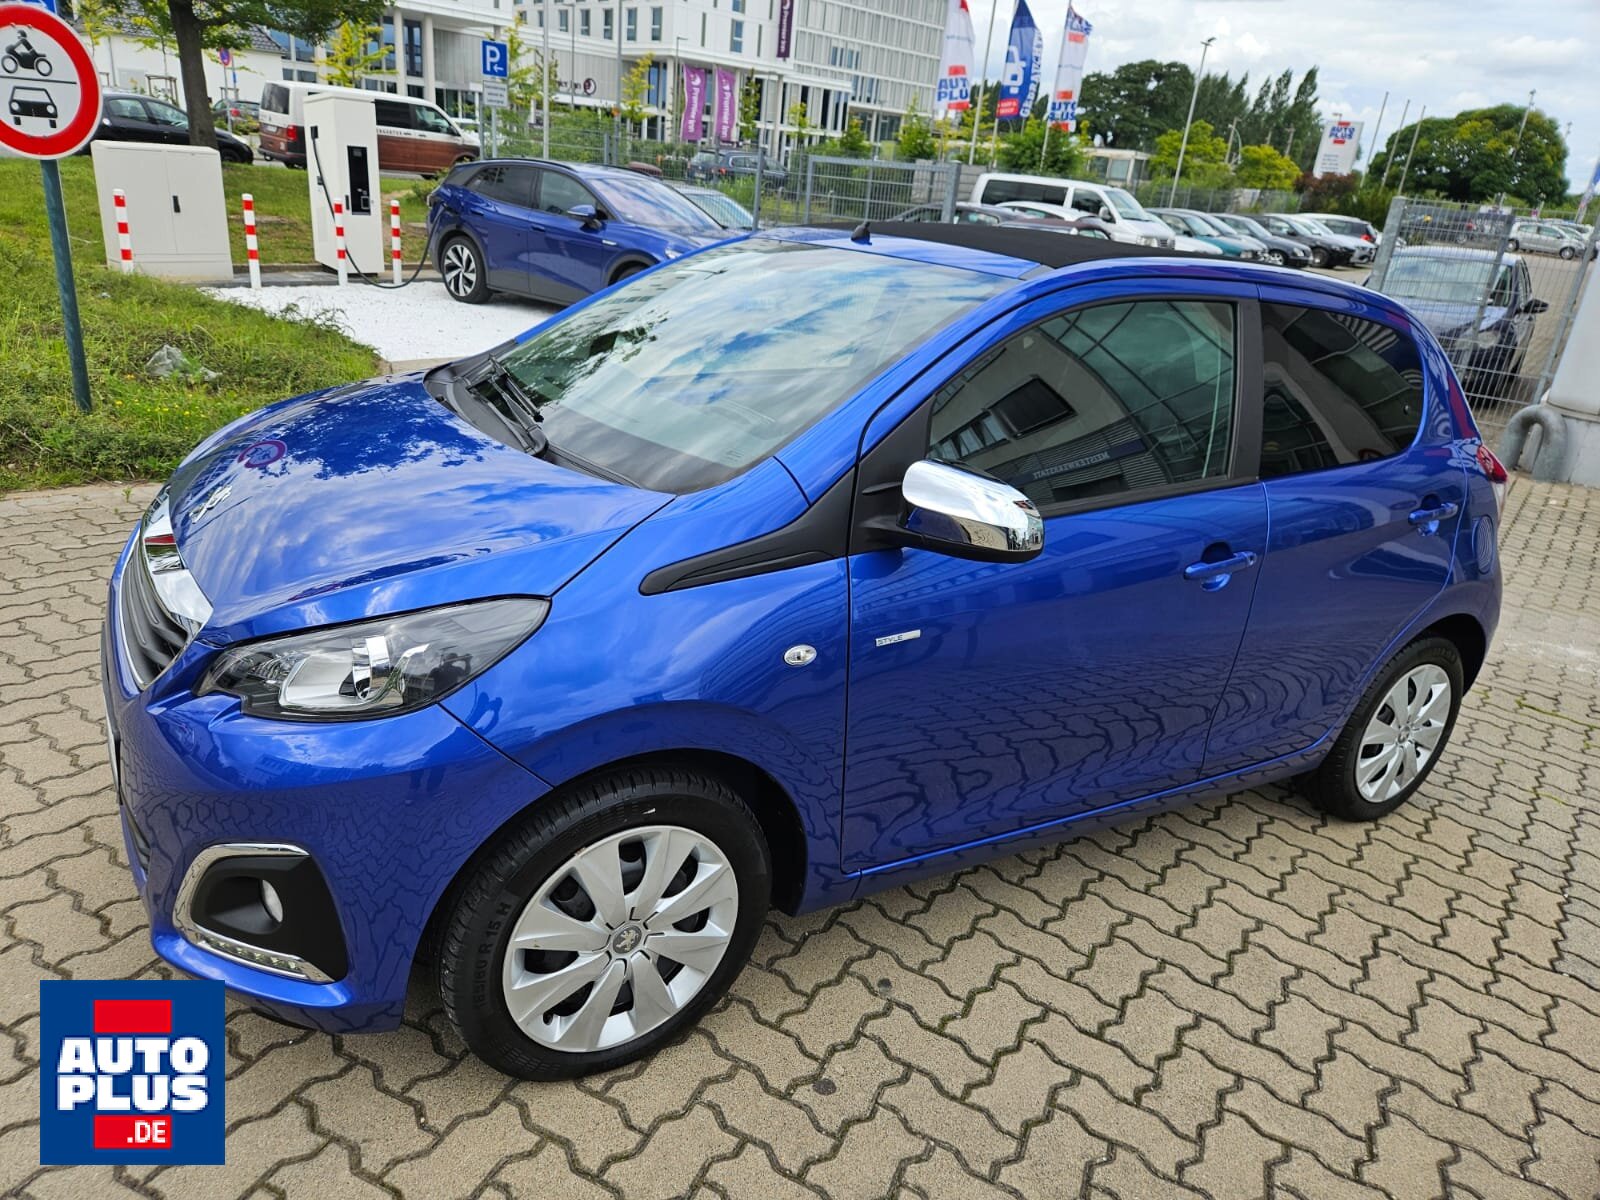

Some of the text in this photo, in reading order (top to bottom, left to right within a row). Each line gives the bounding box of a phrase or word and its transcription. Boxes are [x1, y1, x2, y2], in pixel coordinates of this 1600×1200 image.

[486, 45, 501, 72] P
[937, 89, 969, 102] PLU
[938, 77, 969, 92] AUT
[687, 87, 701, 133] Premier Inn
[721, 91, 732, 138] Premier Inn
[877, 634, 904, 646] STYLE
[480, 944, 494, 955] R
[487, 921, 502, 937] 15
[498, 902, 513, 916] H
